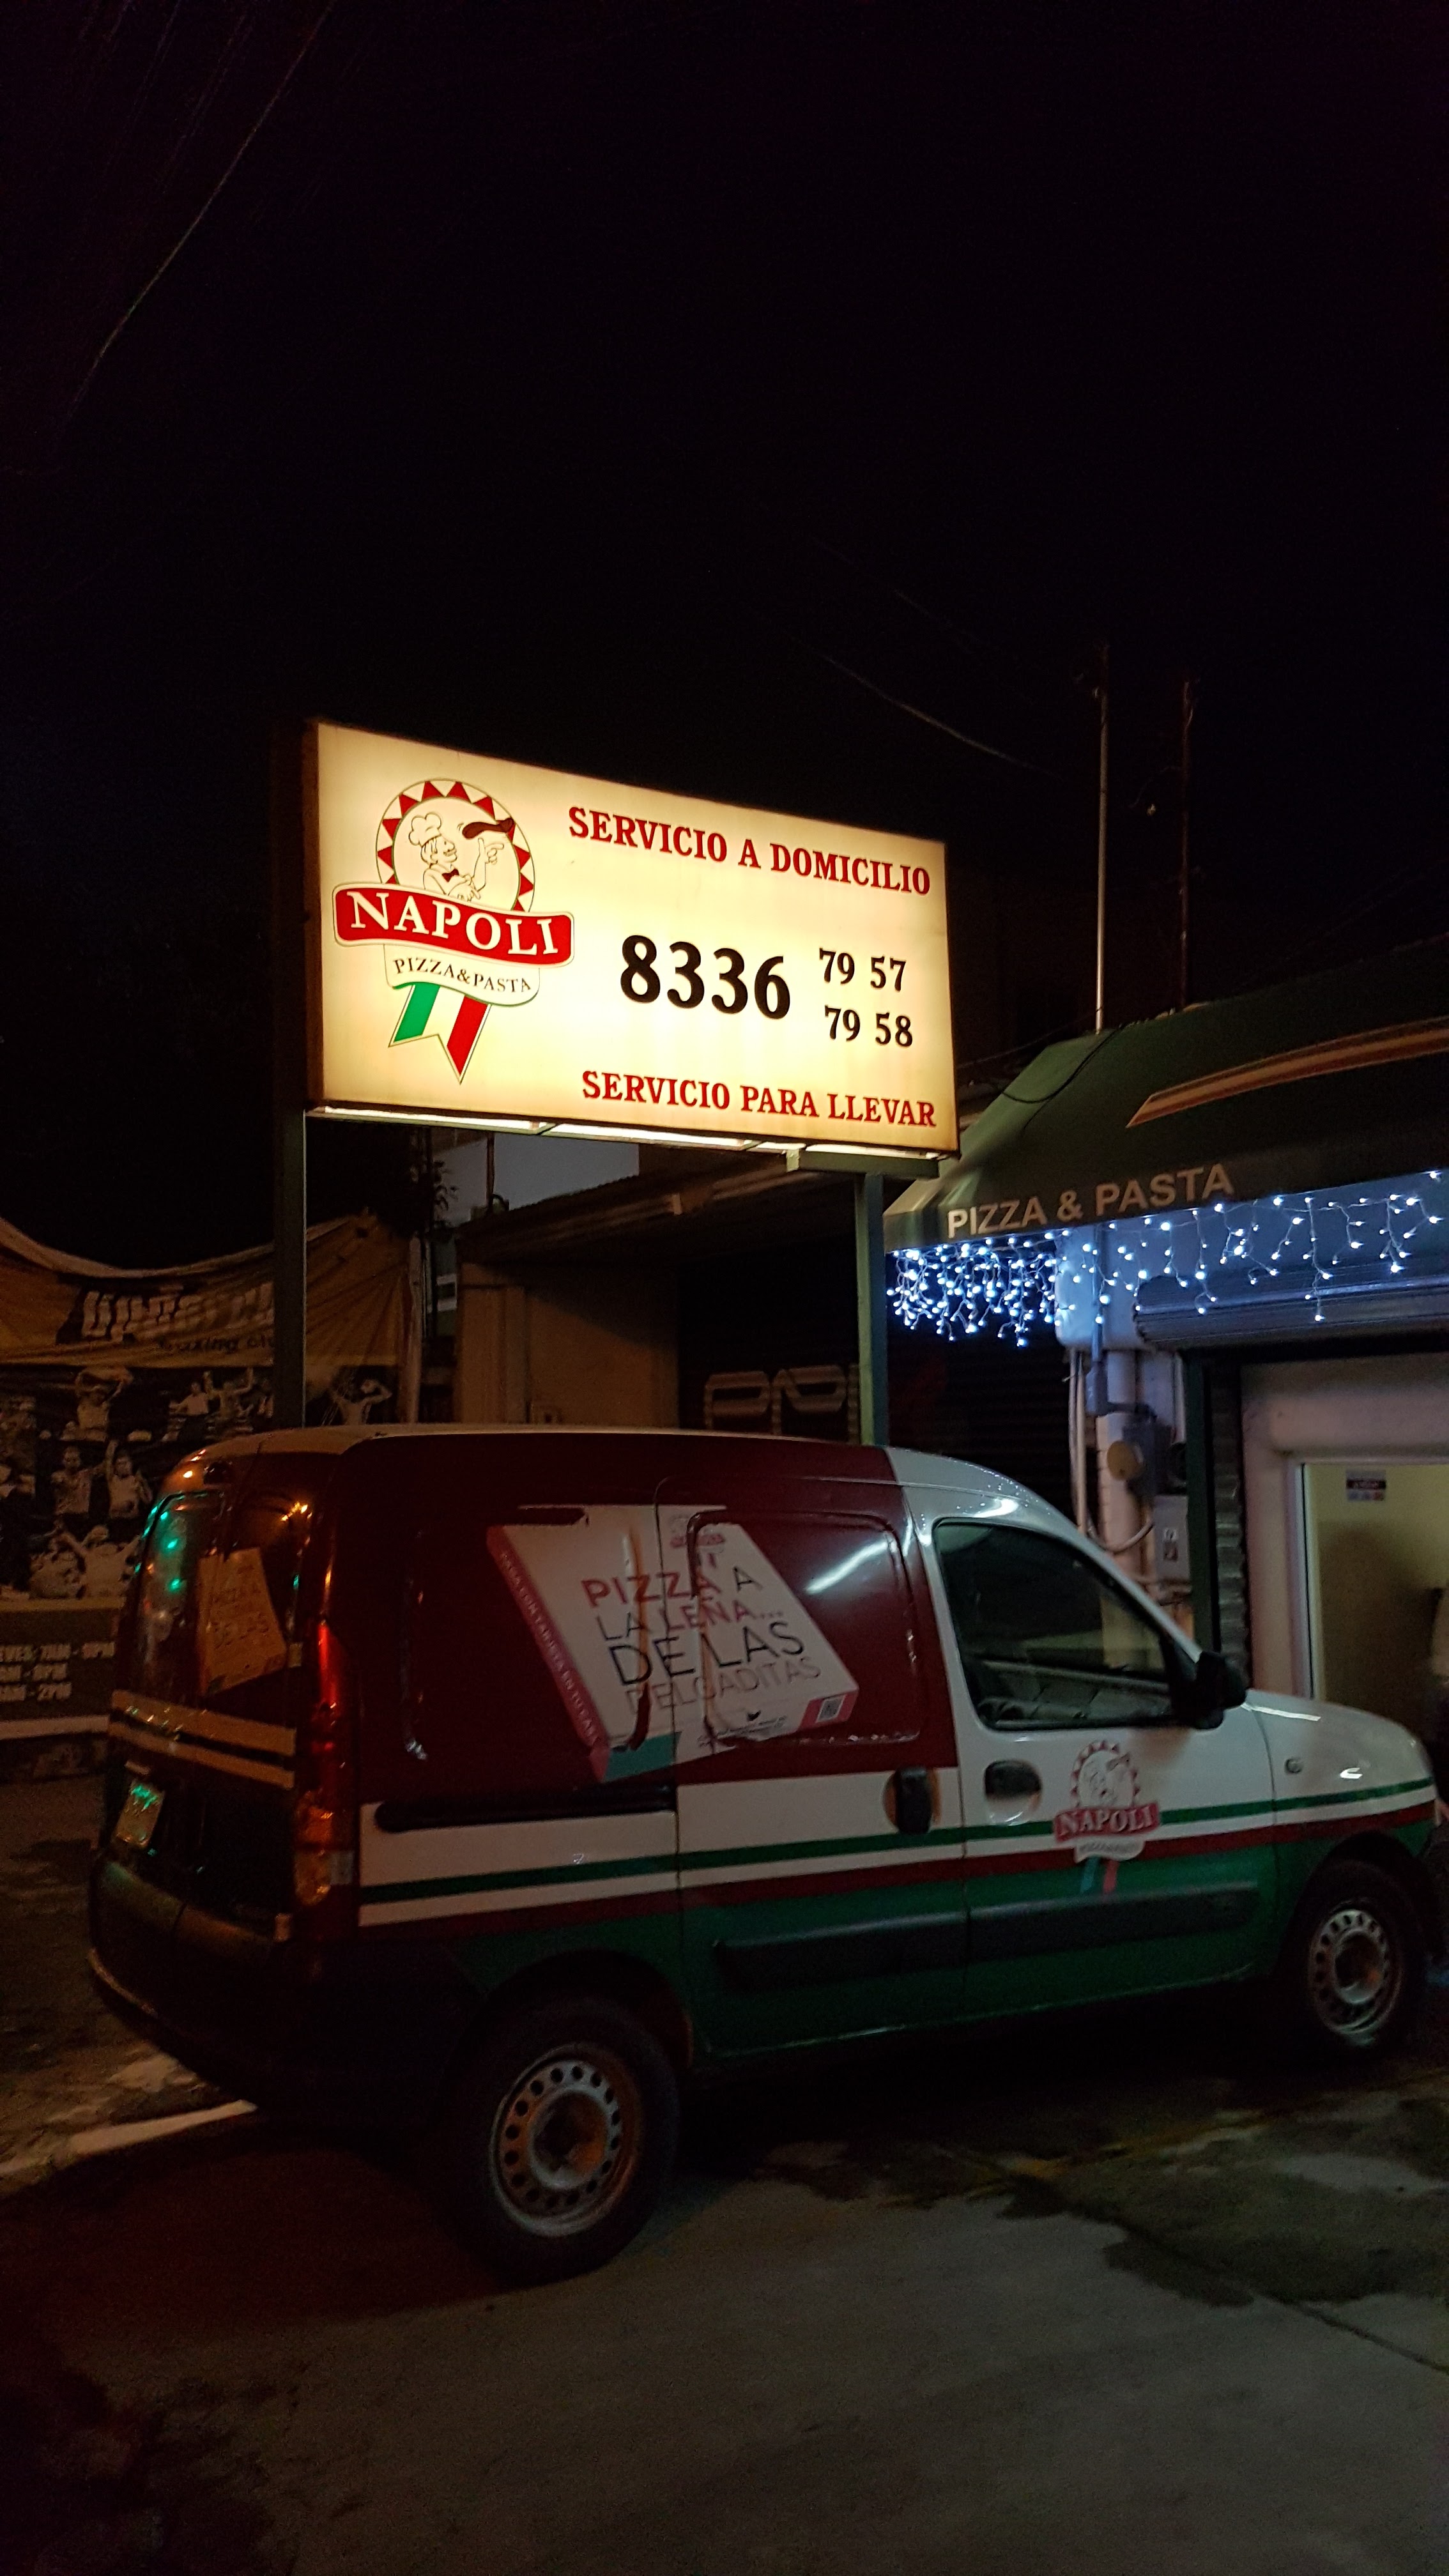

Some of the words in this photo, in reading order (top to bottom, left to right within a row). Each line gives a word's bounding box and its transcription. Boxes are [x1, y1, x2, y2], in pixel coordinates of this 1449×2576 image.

[568, 806, 728, 863] SERVICIO
[737, 838, 761, 869] A
[769, 843, 931, 896] DOMICILIO
[347, 891, 558, 955] NAPOLI
[394, 956, 532, 992] PIZZA&PASTA
[620, 934, 791, 1020] 8336
[818, 947, 855, 985] 79
[870, 954, 907, 992] 57
[824, 1004, 861, 1041] 79
[875, 1011, 914, 1048] 58
[582, 1070, 730, 1110] SERVICIO
[739, 1085, 820, 1118] PARA
[827, 1093, 937, 1128] LLEVAR
[947, 1195, 1048, 1239] PIZZA
[1056, 1189, 1085, 1223] &
[1094, 1162, 1234, 1216] PASTA
[581, 1568, 721, 1608] PIZZA
[732, 1566, 763, 1592] A
[596, 1610, 648, 1641] LA
[609, 1636, 696, 1685] DE
[700, 1620, 804, 1668] LAS
[1057, 1805, 1154, 1837] NAPOLI
